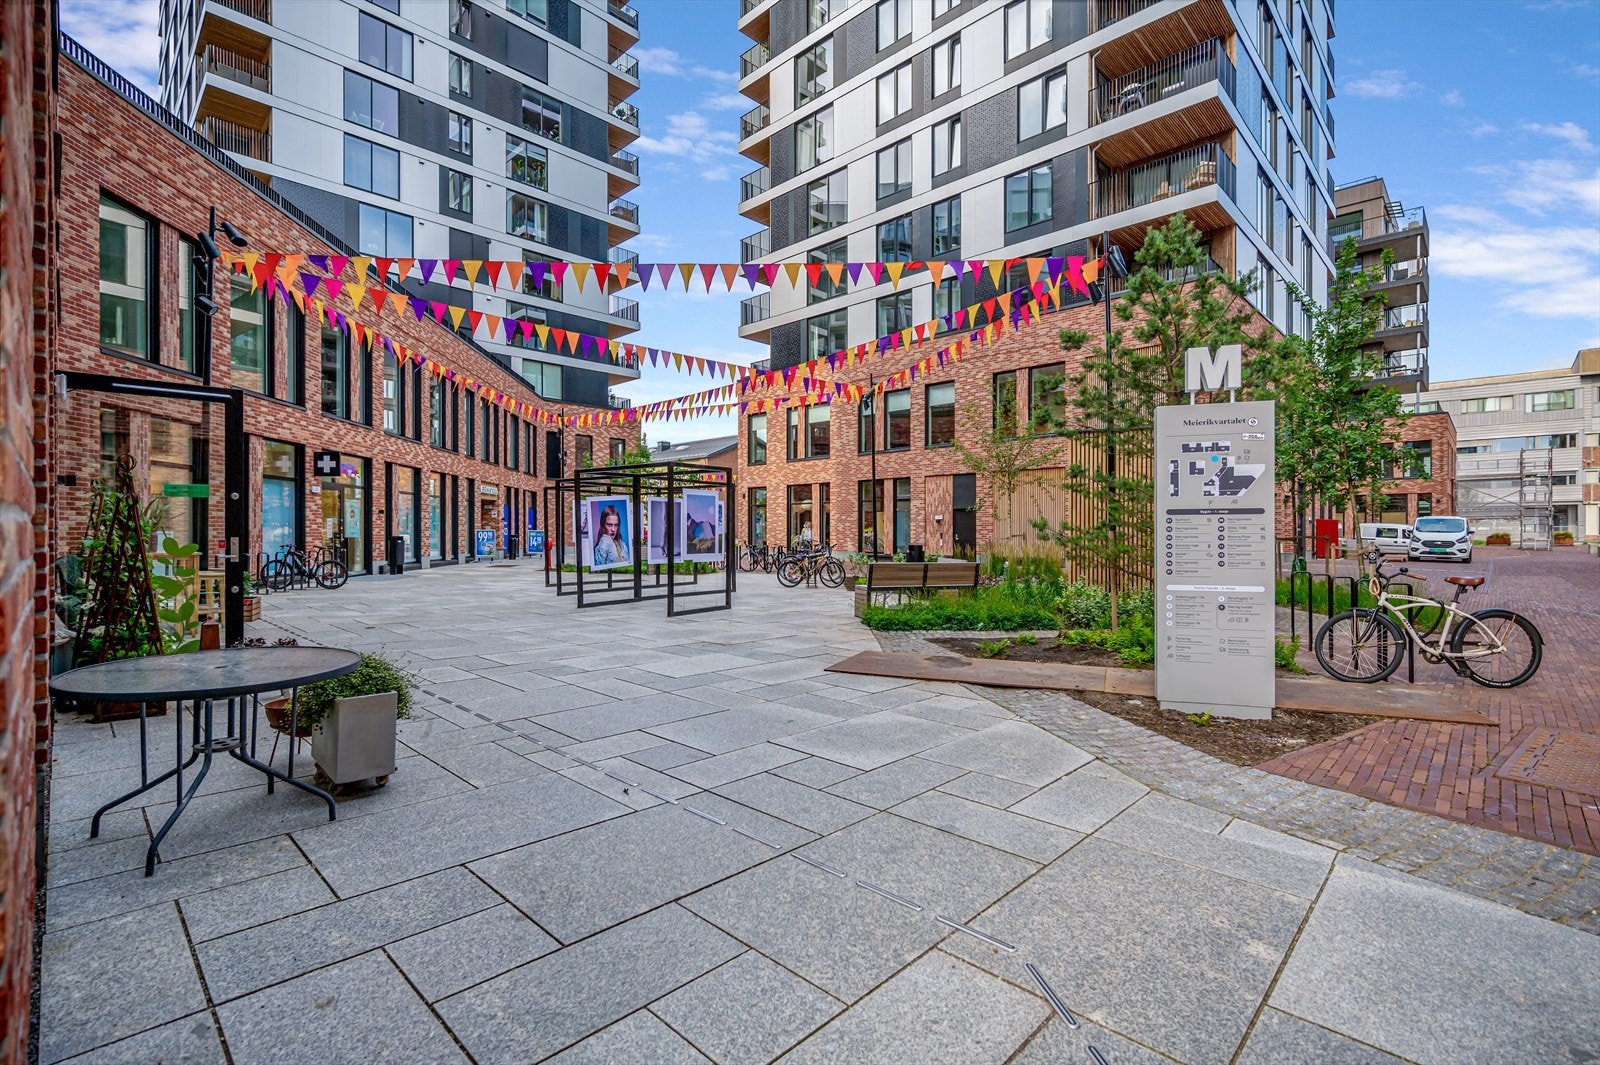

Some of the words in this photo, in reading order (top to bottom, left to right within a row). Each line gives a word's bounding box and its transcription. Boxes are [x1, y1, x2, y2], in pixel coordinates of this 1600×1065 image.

[1185, 344, 1241, 393] M
[1183, 418, 1246, 426] Meierikvartalet
[478, 532, 488, 542] 99
[530, 536, 537, 546] 14
